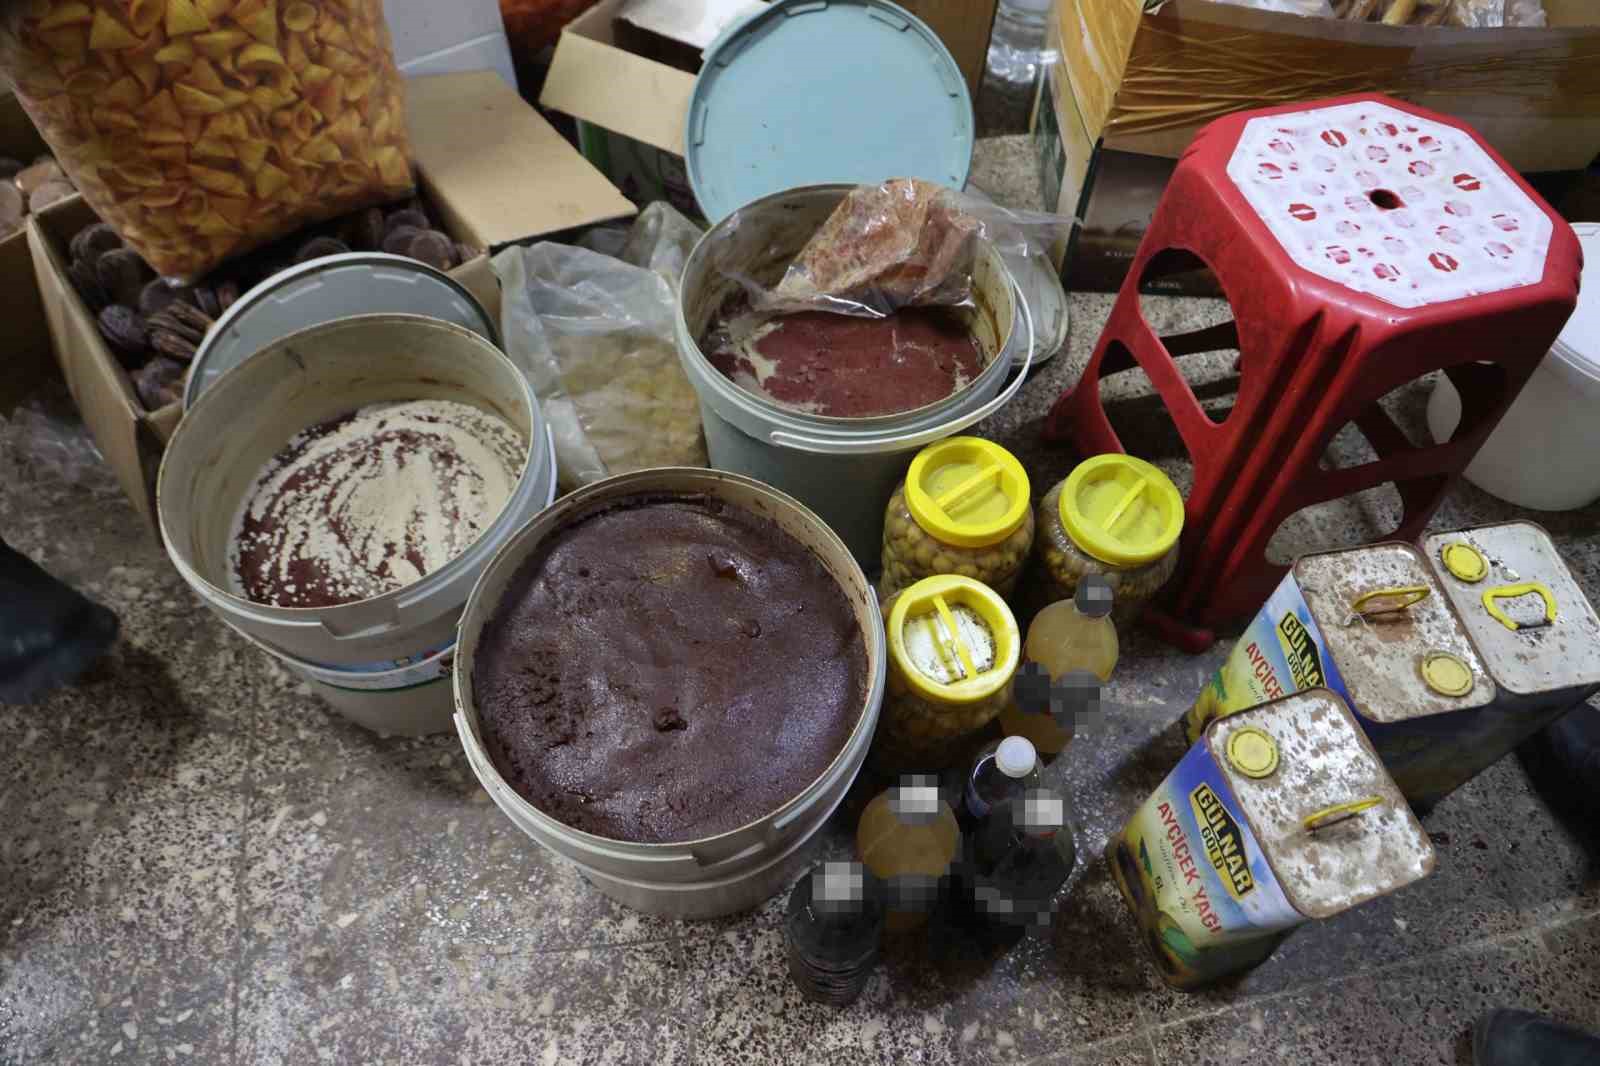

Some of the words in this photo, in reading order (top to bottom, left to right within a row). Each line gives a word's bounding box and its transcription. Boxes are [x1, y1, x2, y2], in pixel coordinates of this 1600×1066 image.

[1246, 642, 1284, 699] AYÇİÇE
[1282, 616, 1322, 688] GÜLNA
[1157, 802, 1200, 886] AYÇİÇEK
[1192, 885, 1222, 933] YAĞI
[1198, 787, 1252, 895] GÜLNAR
[1201, 826, 1224, 870] GOLD
